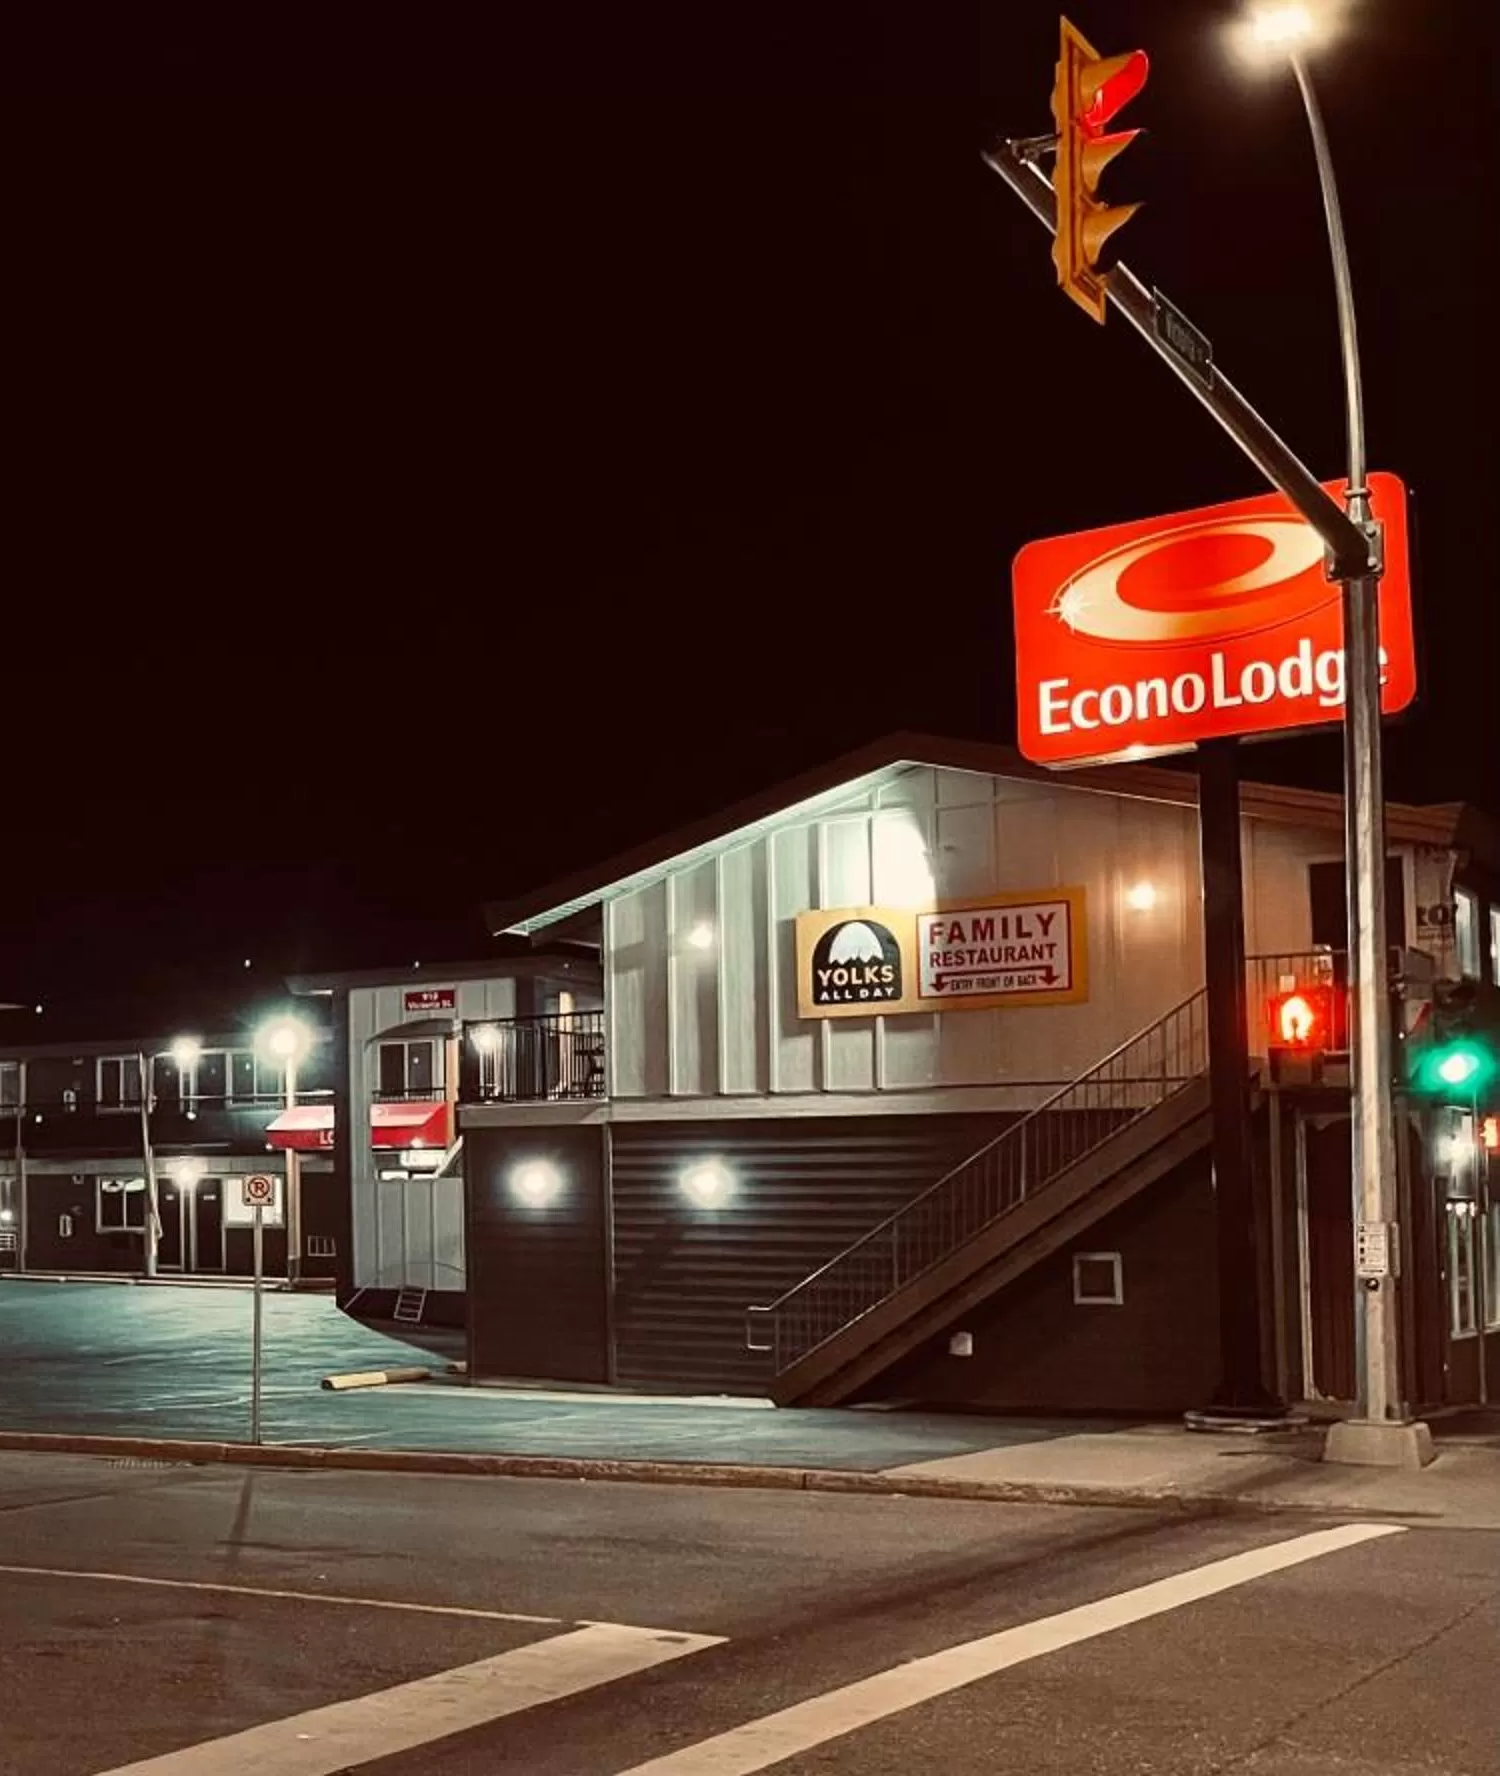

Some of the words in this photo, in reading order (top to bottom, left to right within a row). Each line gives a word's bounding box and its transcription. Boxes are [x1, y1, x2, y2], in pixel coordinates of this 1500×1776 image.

[1212, 638, 1388, 707] Lodg
[929, 911, 1056, 945] FAMILY
[929, 943, 1057, 968] RESTAURANT
[817, 965, 894, 987] YOLKS
[1003, 975, 1014, 988] OR
[820, 989, 853, 1001] ALL
[859, 987, 894, 999] DAY
